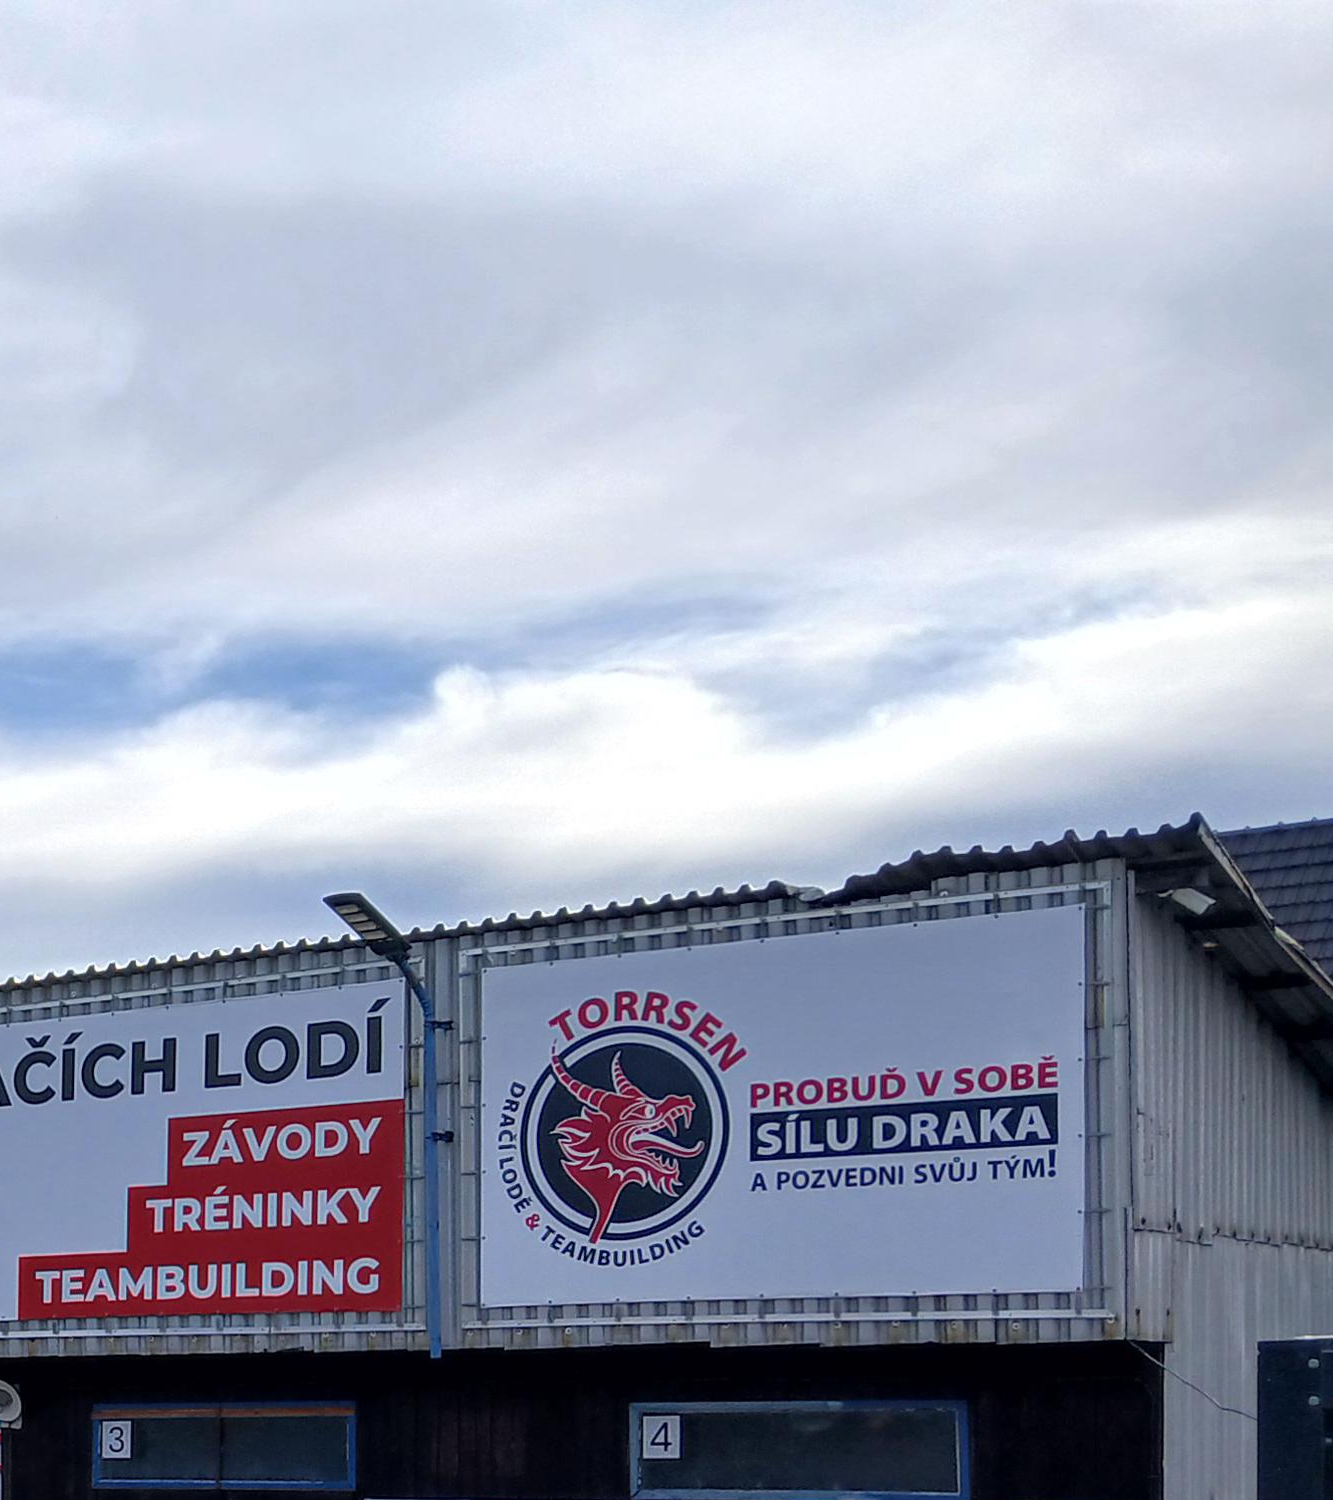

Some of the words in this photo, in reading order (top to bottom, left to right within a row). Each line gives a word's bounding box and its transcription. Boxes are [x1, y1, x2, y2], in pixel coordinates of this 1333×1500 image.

[203, 999, 389, 1088] LODÍ
[548, 990, 748, 1073] TORRSEN
[750, 1066, 907, 1109] PROBUĎ
[917, 1069, 943, 1096] V
[954, 1055, 1060, 1092] SOBĚ
[181, 1116, 384, 1169] ZÁVODY
[497, 1080, 526, 1156] DRAČÍ
[756, 1110, 859, 1156] SÍLU
[870, 1106, 1052, 1151] DRAKA
[497, 1157, 533, 1214] LODĚ
[751, 1173, 768, 1192] A
[776, 1165, 906, 1191] POZVEDNI
[913, 1157, 978, 1185] SVŮJ
[988, 1148, 1057, 1181] TÝM!
[145, 1184, 383, 1234] TRÉNINKY
[539, 1219, 706, 1269] TEAMBUILDING
[34, 1257, 382, 1305] TEAMBUILDING
[108, 1426, 124, 1453] 3
[650, 1421, 673, 1452] 4
